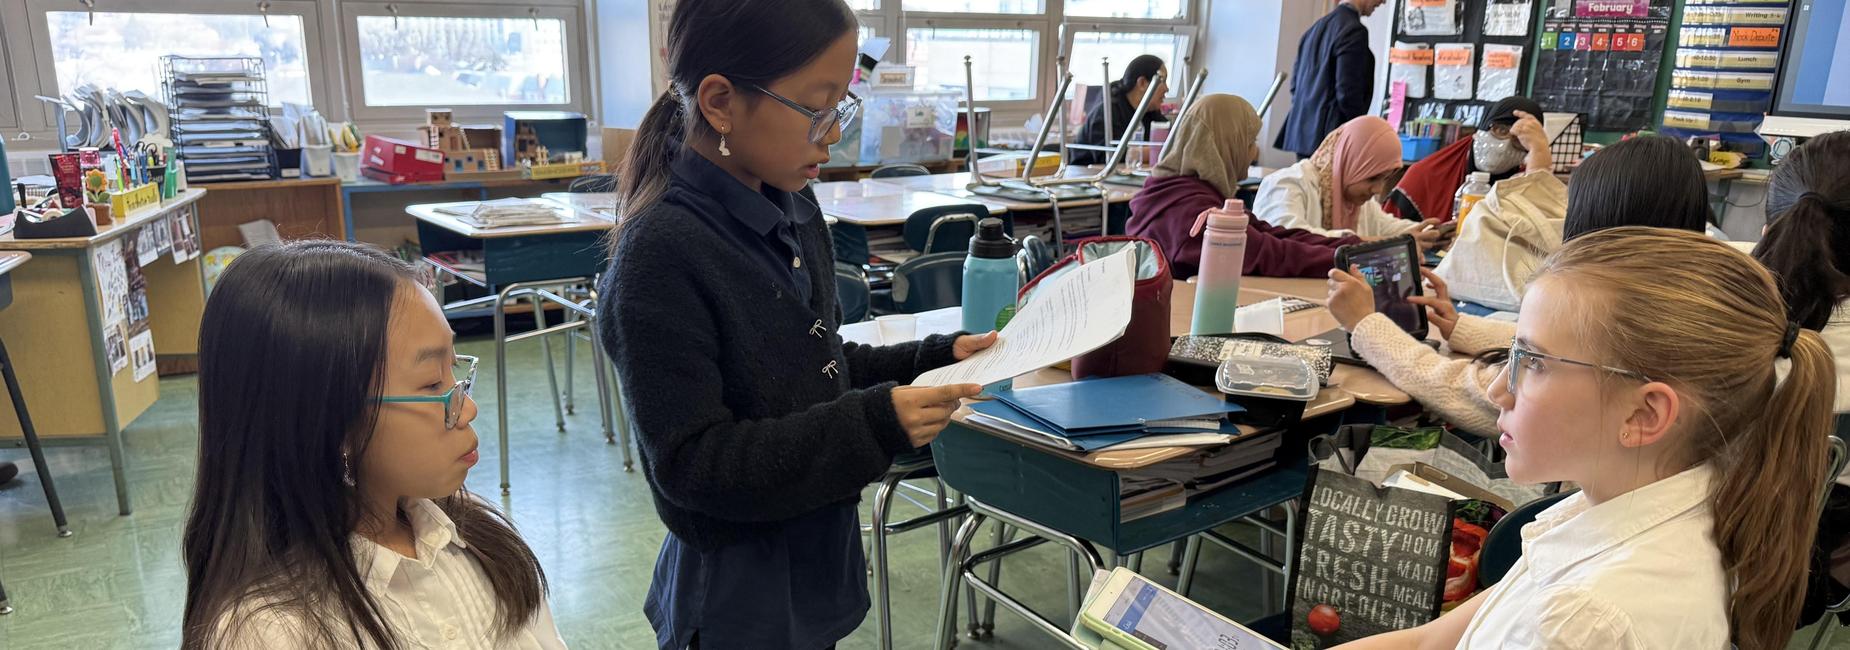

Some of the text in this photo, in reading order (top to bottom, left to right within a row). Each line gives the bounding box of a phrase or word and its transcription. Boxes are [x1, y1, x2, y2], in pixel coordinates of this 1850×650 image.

[1588, 2, 1634, 14] February
[1564, 36, 1571, 46] 2
[1579, 37, 1586, 46] 3
[1596, 38, 1603, 47] 4
[1616, 38, 1623, 47] 5
[1631, 38, 1638, 47] 6
[1310, 485, 1448, 536] LOCALLY GROW
[1308, 508, 1400, 563] TASTY
[1299, 543, 1390, 597] FRESH
[1397, 559, 1439, 584] MAD
